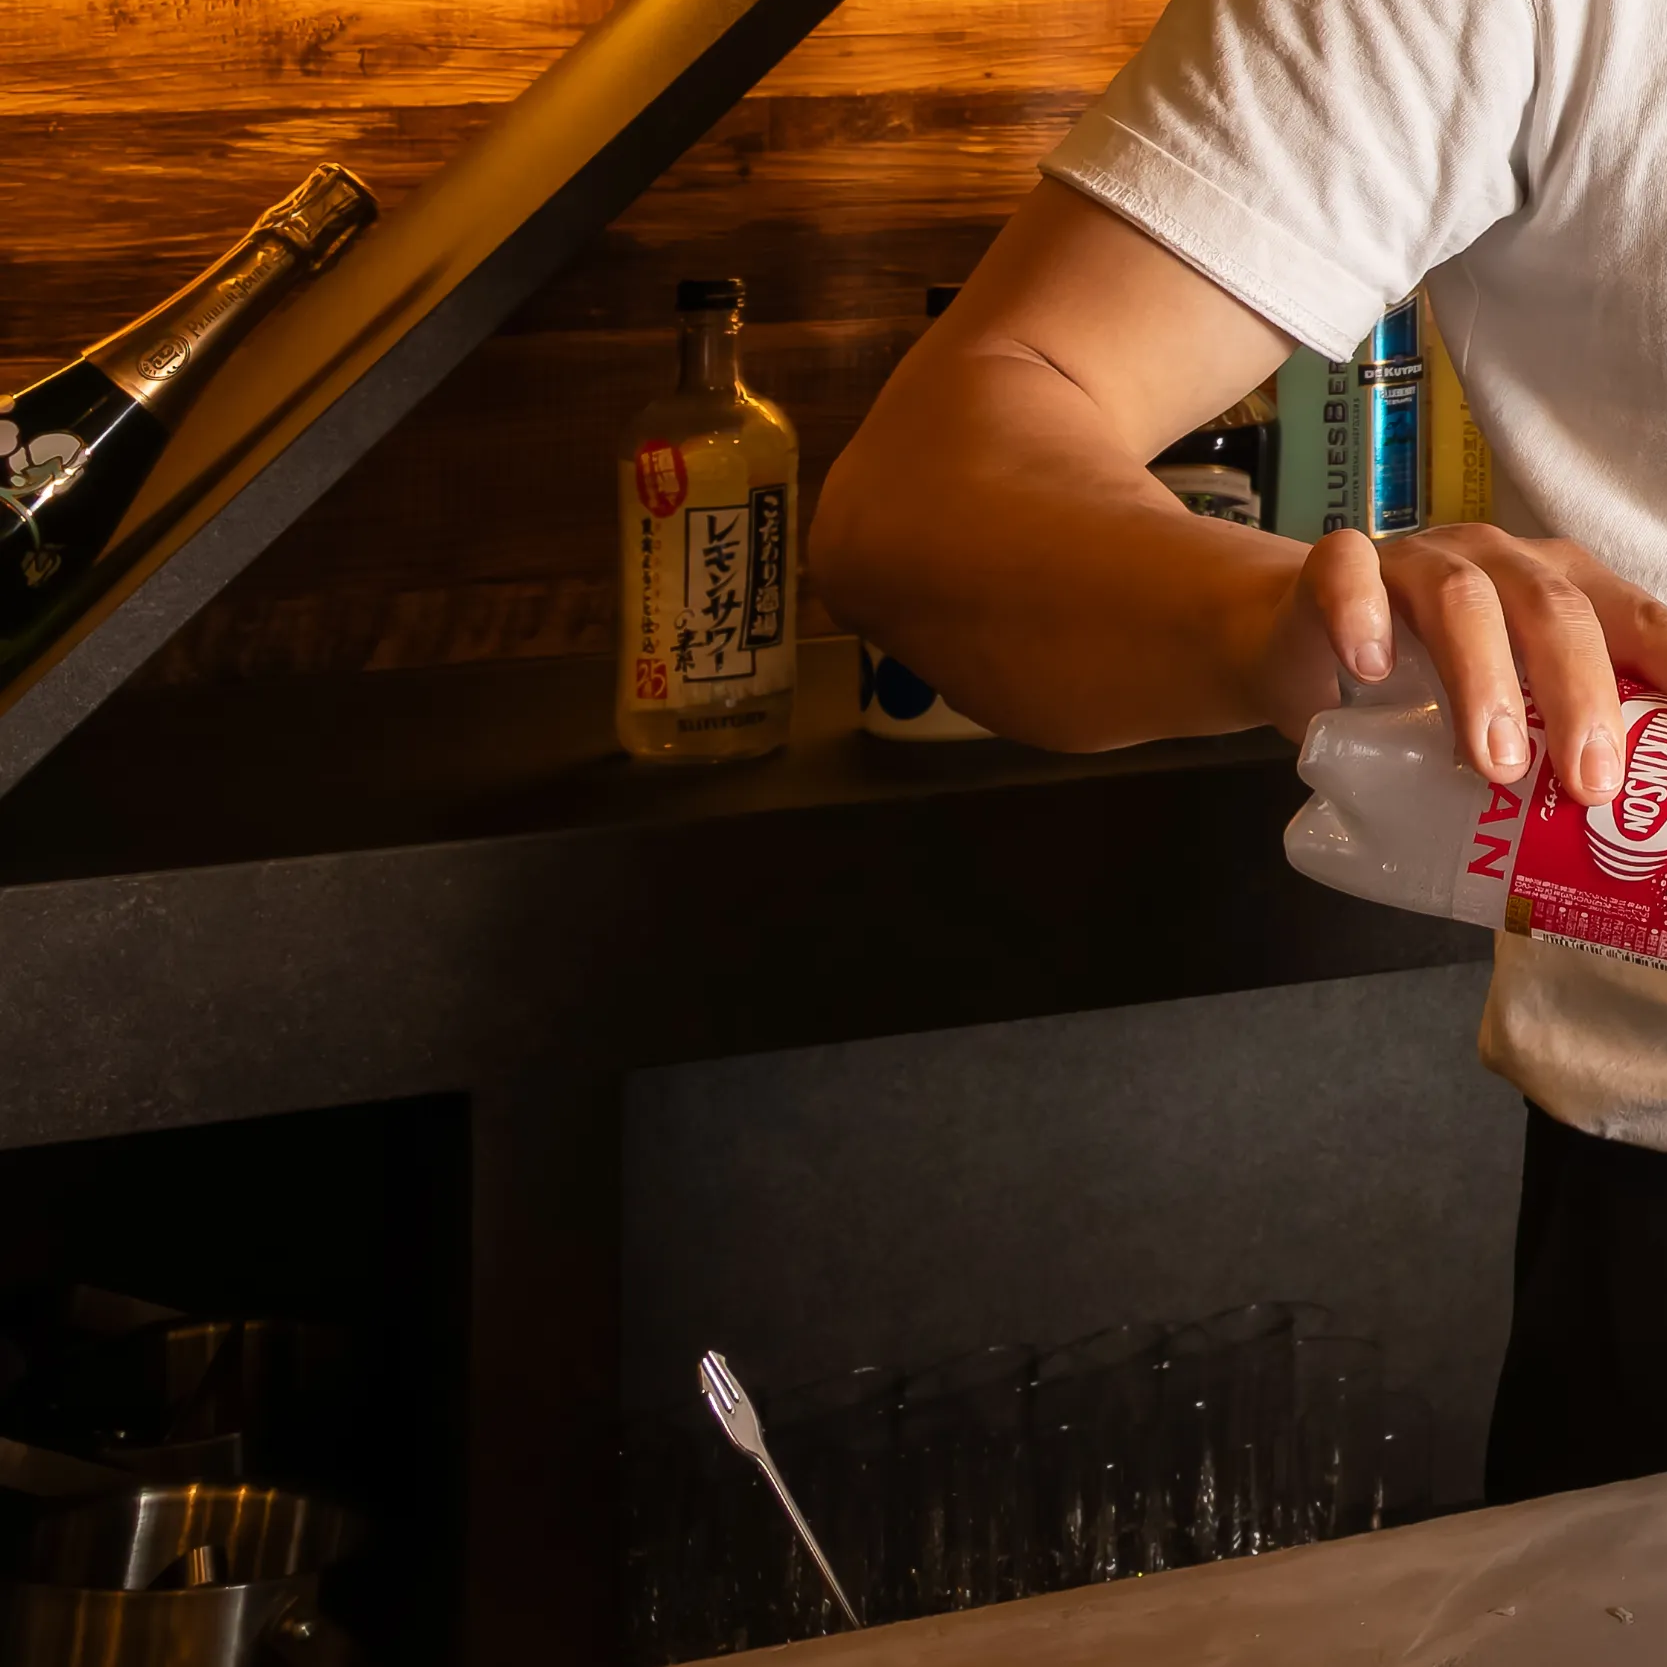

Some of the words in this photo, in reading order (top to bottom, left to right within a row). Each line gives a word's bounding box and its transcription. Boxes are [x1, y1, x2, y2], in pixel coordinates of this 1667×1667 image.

[1384, 363, 1423, 377] KUYPER
[701, 512, 743, 673] レモンサワー
